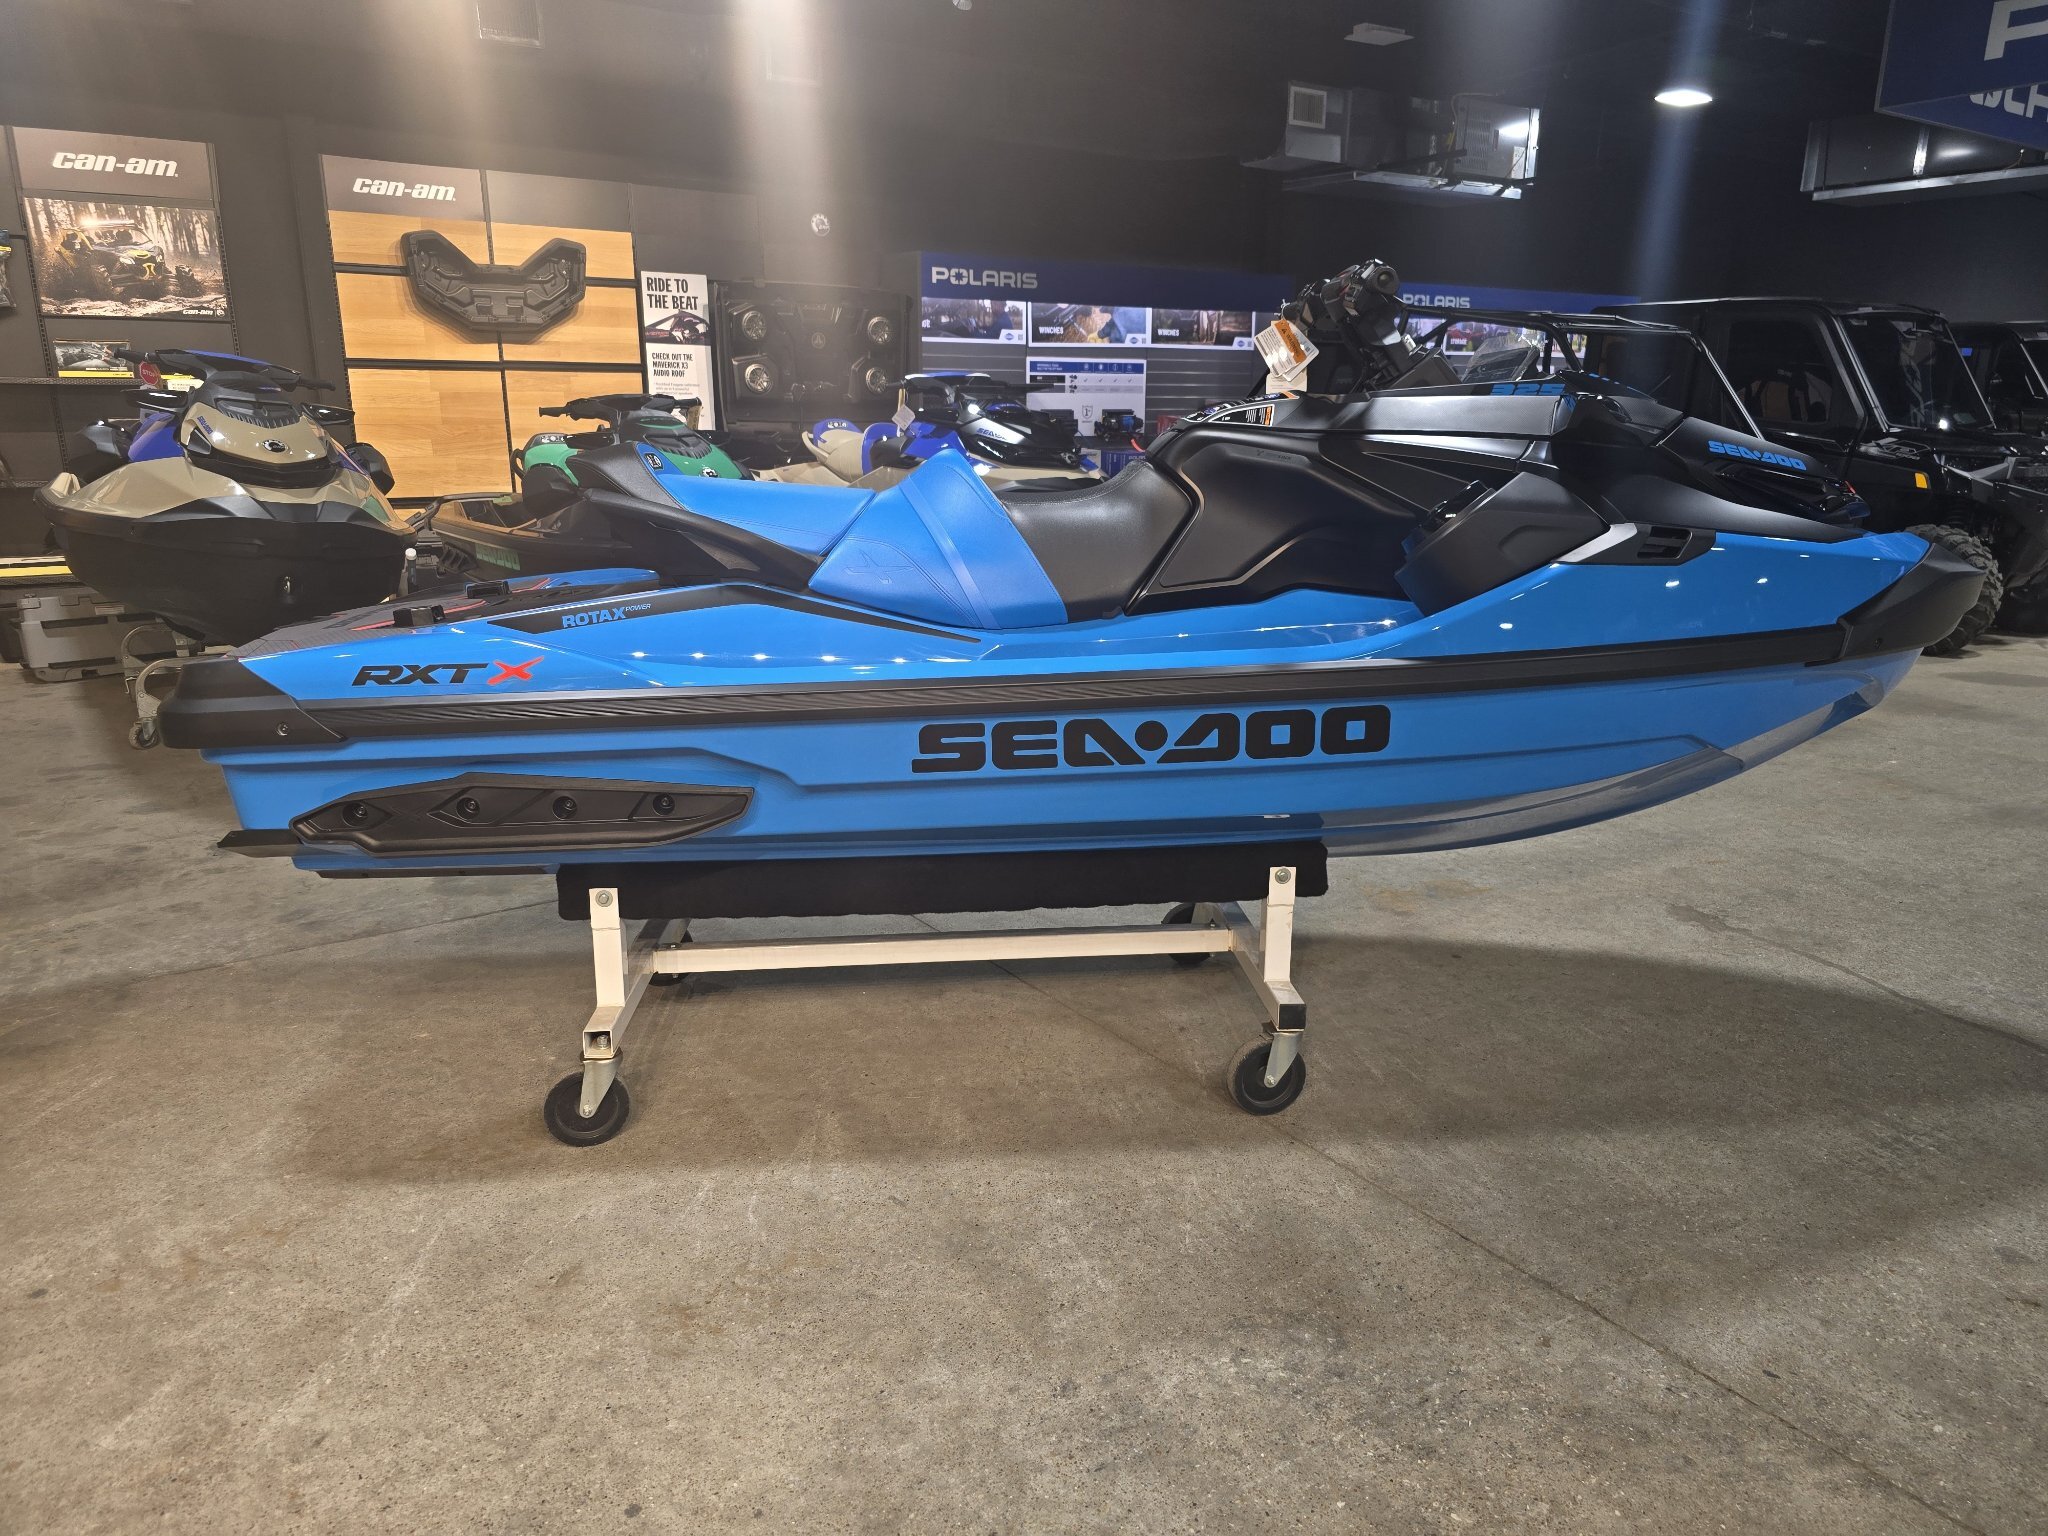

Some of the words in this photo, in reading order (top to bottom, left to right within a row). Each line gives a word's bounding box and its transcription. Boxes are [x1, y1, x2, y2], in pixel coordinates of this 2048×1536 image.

[646, 276, 673, 293] RIDE
[674, 278, 689, 293] TO
[931, 266, 1038, 289] POLARIS
[646, 293, 669, 309] THE
[671, 295, 698, 311] BEAT
[1402, 293, 1471, 309] POLARIS
[1038, 326, 1064, 335] WINCHES
[1157, 328, 1180, 337] WINCHES
[651, 352, 671, 361] CHECK
[671, 353, 682, 361] OUT
[683, 353, 694, 361] THE
[652, 360, 681, 370] MAVERICK
[681, 362, 689, 370] X3
[653, 369, 670, 377] AUDIO
[671, 370, 686, 378] ROOF
[1490, 383, 1565, 396] 325
[562, 606, 627, 629] ROTAX
[625, 603, 651, 612] POWER
[351, 662, 489, 687] RXT
